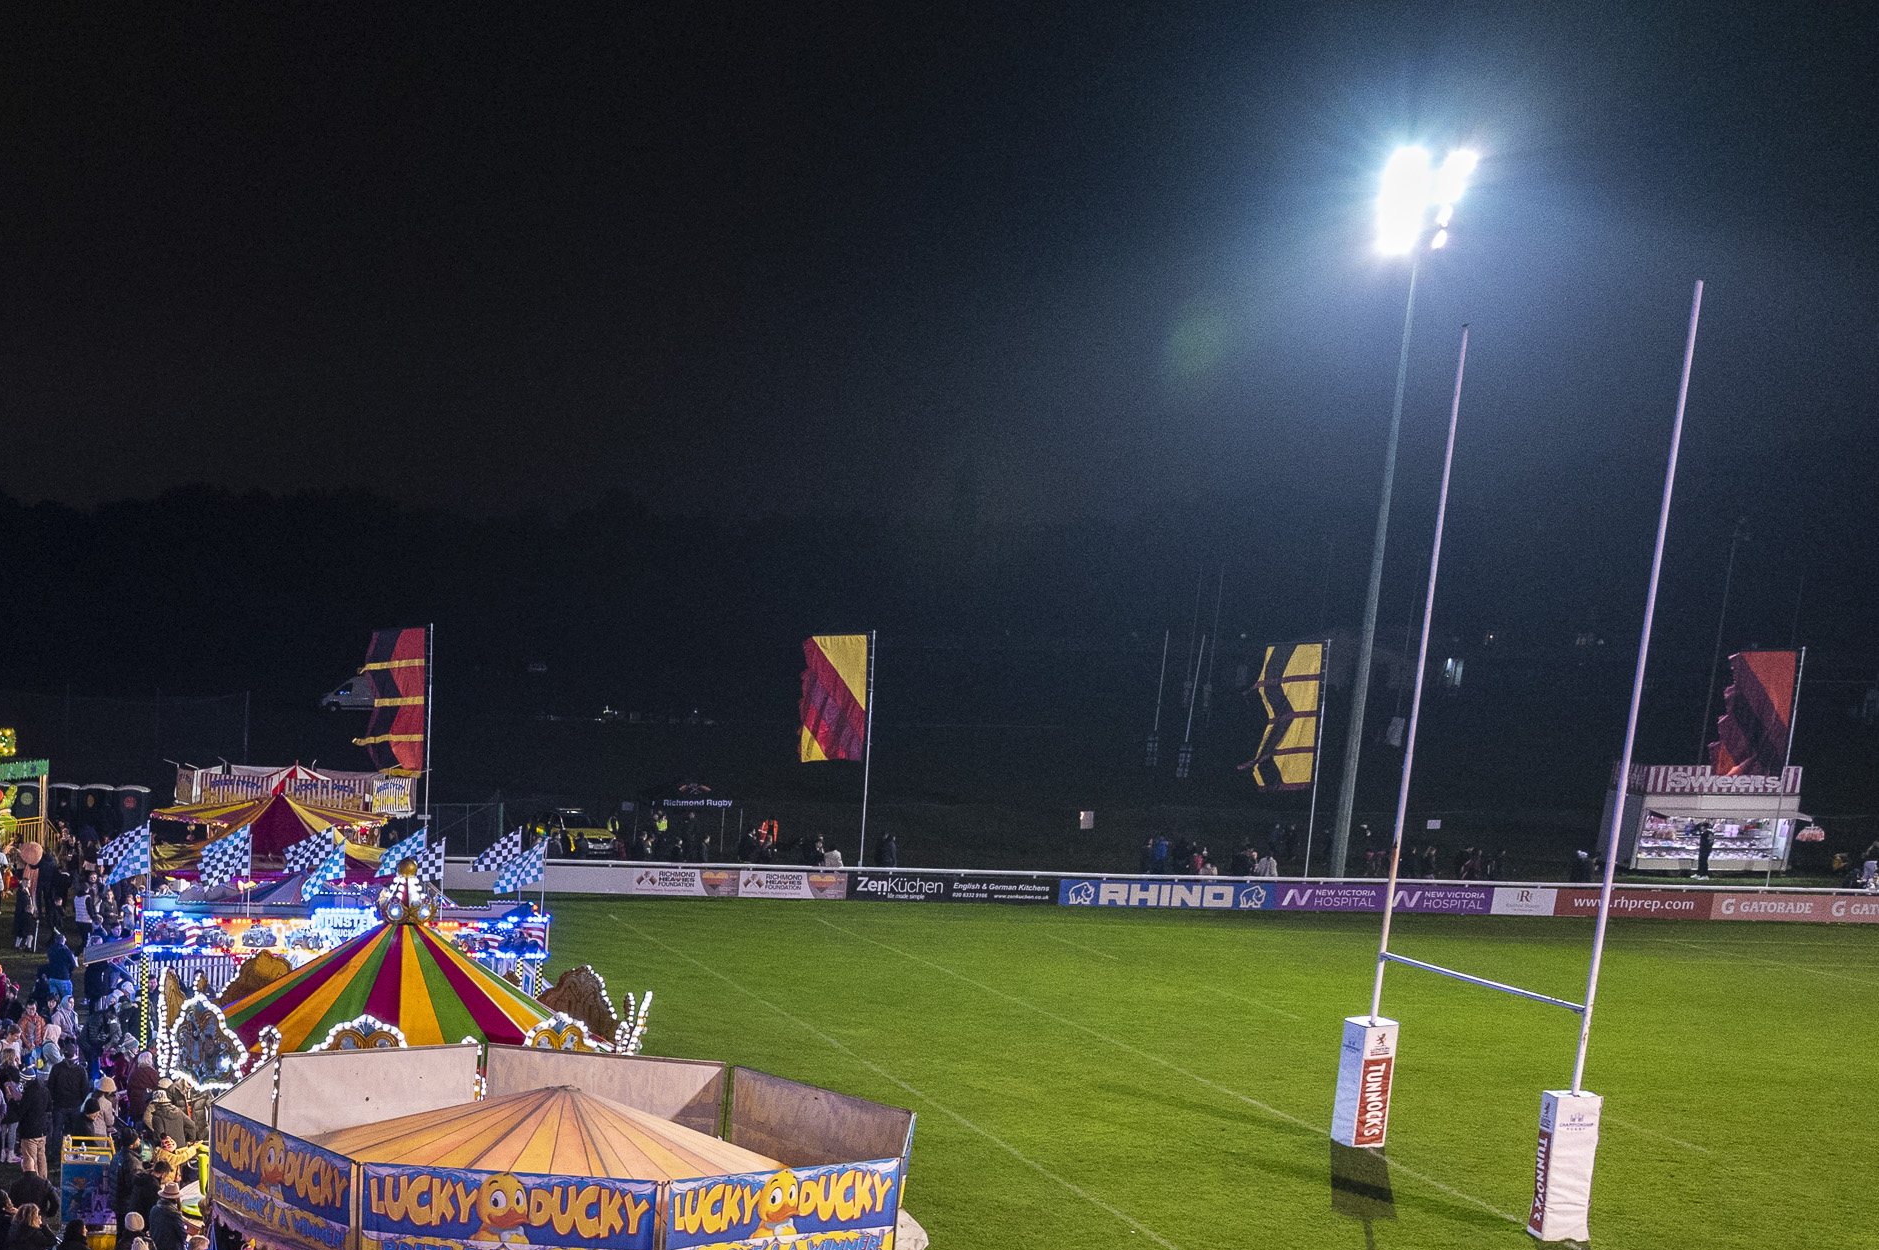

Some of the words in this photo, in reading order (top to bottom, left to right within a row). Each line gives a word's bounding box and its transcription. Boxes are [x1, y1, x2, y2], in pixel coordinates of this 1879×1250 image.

[1669, 772, 1783, 789] Sweets
[663, 799, 705, 807] Richmond
[706, 799, 733, 808] Rugby
[953, 882, 981, 891] English
[1018, 884, 1050, 892] Kitchens
[1098, 883, 1235, 907] RHINO
[1336, 889, 1376, 897] VICTORIA
[1314, 897, 1375, 907] HOSPITAL
[1422, 899, 1484, 910] HOSPITAL
[1740, 900, 1814, 914] GATORADE
[1363, 1062, 1387, 1137] TUNNOCK'S
[214, 1119, 262, 1173] LUCKY
[283, 1151, 349, 1208] DUCKY
[369, 1174, 478, 1226] LUCKY
[529, 1184, 651, 1239] DUCKY
[673, 1181, 762, 1235] LUCKY
[797, 1169, 894, 1223] DUCKY
[214, 1176, 274, 1221] EVERYONE'S
[278, 1208, 289, 1228] A
[291, 1213, 346, 1250] WINNER!
